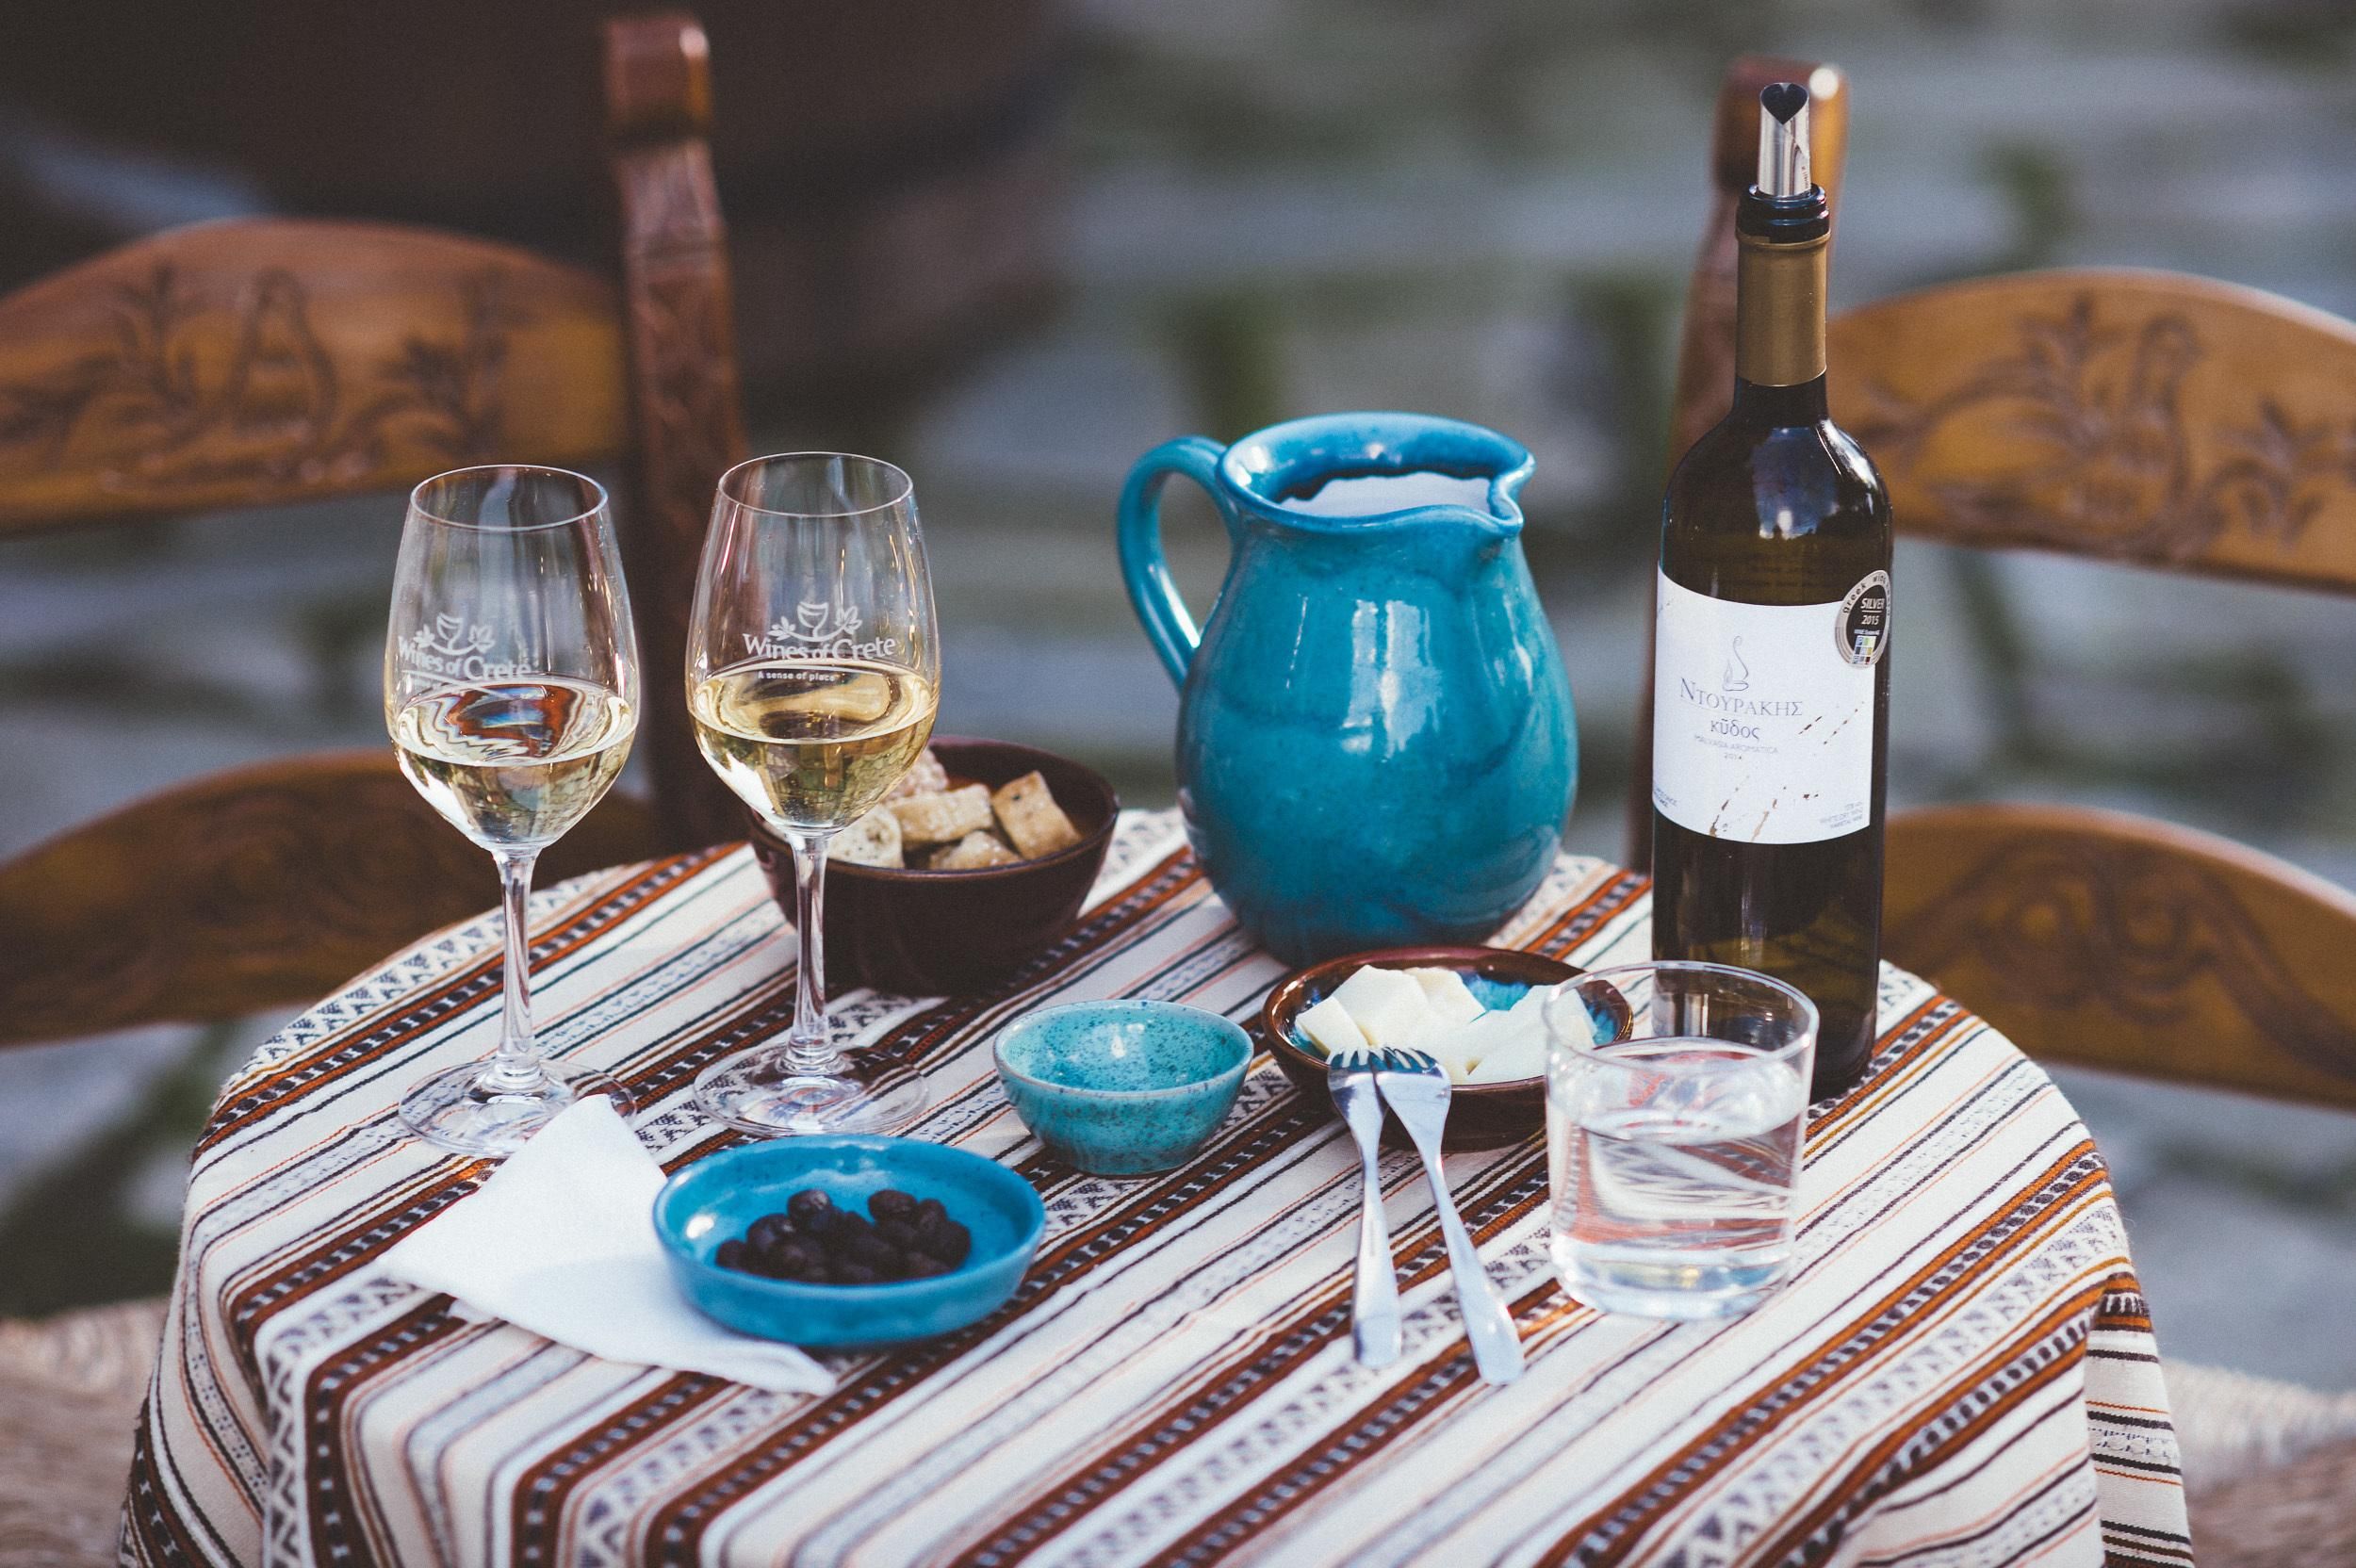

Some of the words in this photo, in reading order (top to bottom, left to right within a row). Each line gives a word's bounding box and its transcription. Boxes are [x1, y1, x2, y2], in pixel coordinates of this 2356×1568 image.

[1860, 597, 1885, 610] SILVER
[1861, 614, 1880, 625] 2015
[743, 633, 808, 659] Wines
[812, 643, 831, 659] of
[831, 638, 895, 661] Crete
[464, 656, 532, 679] Crete
[758, 670, 764, 678] A
[795, 671, 808, 679] of
[809, 672, 836, 681] place
